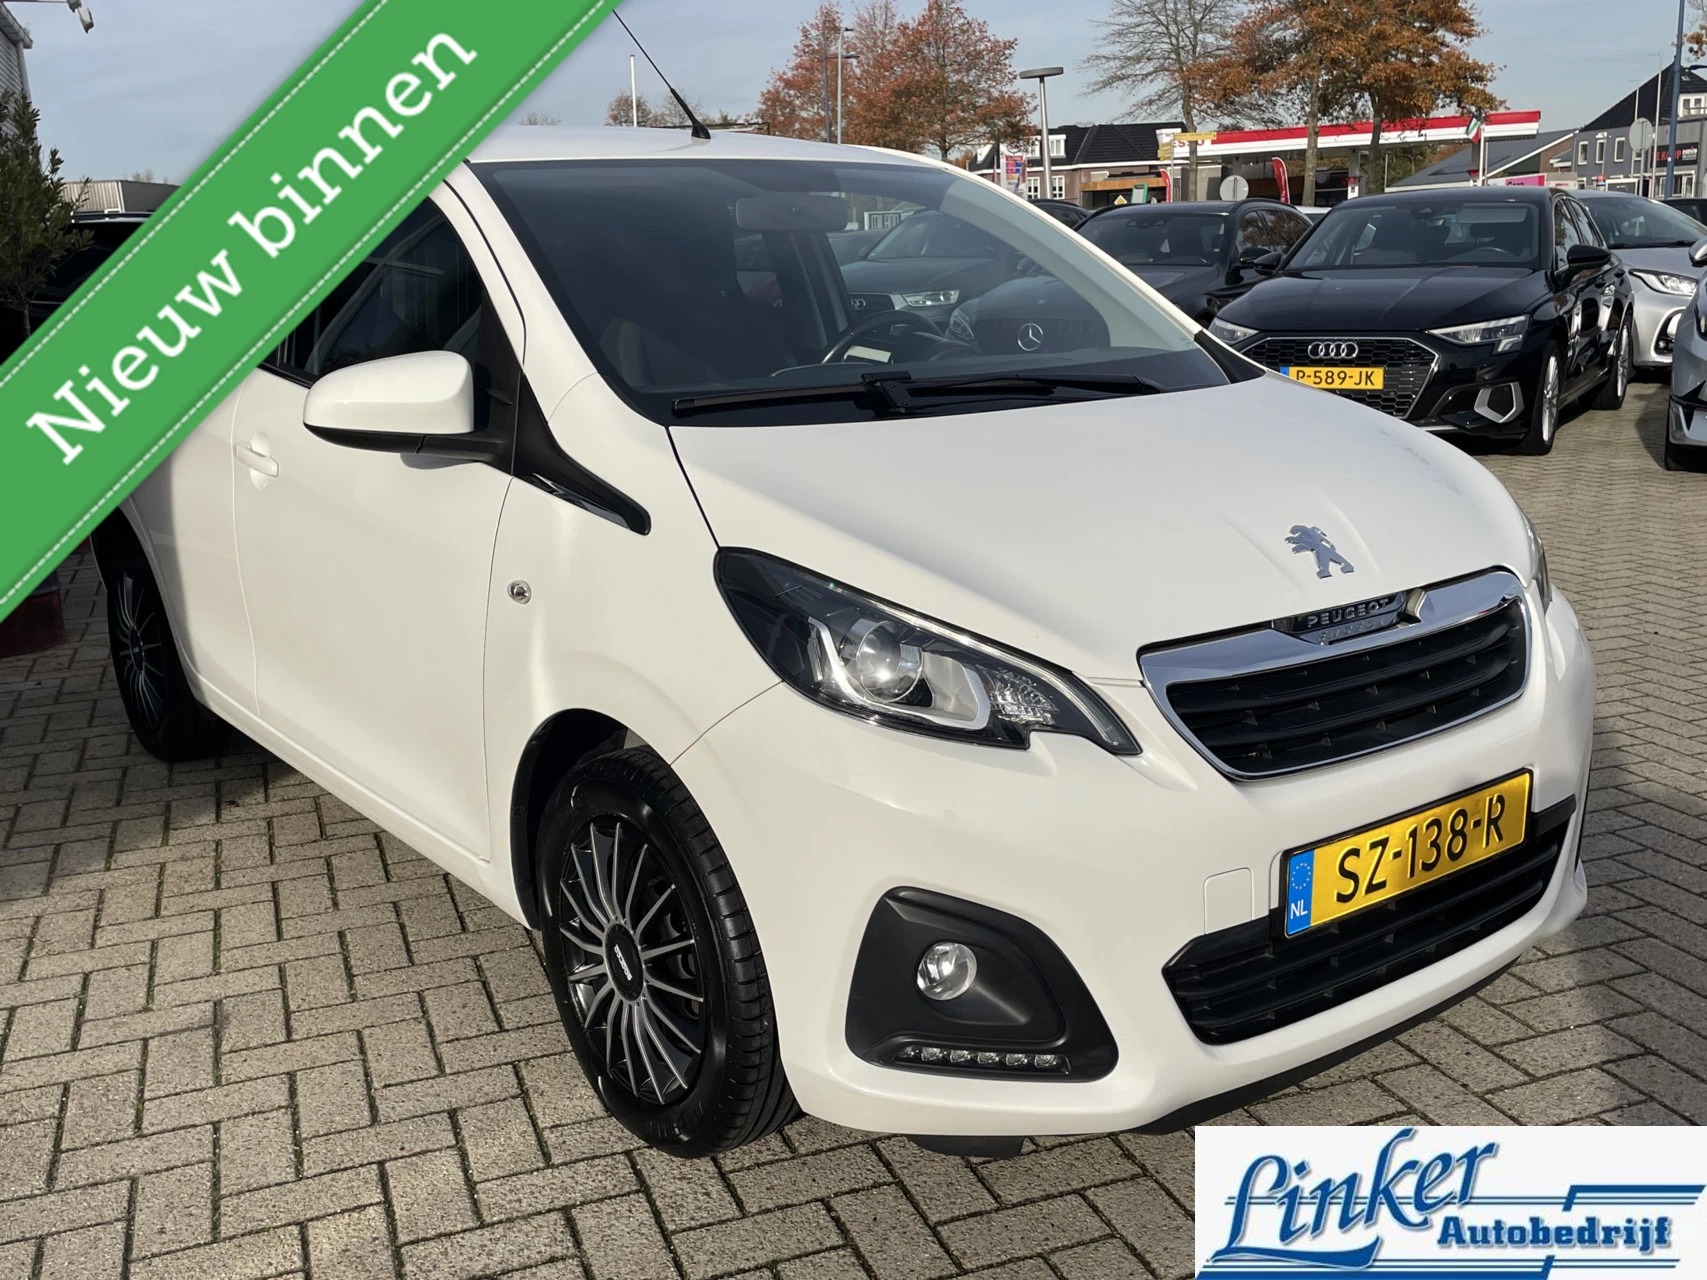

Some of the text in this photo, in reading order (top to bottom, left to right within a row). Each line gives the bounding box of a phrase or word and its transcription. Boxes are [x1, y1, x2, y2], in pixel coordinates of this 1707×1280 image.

[1296, 370, 1375, 386] P-589-JK
[1307, 598, 1389, 628] PEUGEOT
[1334, 794, 1506, 904] SZ-138-R
[1290, 901, 1309, 920] NL
